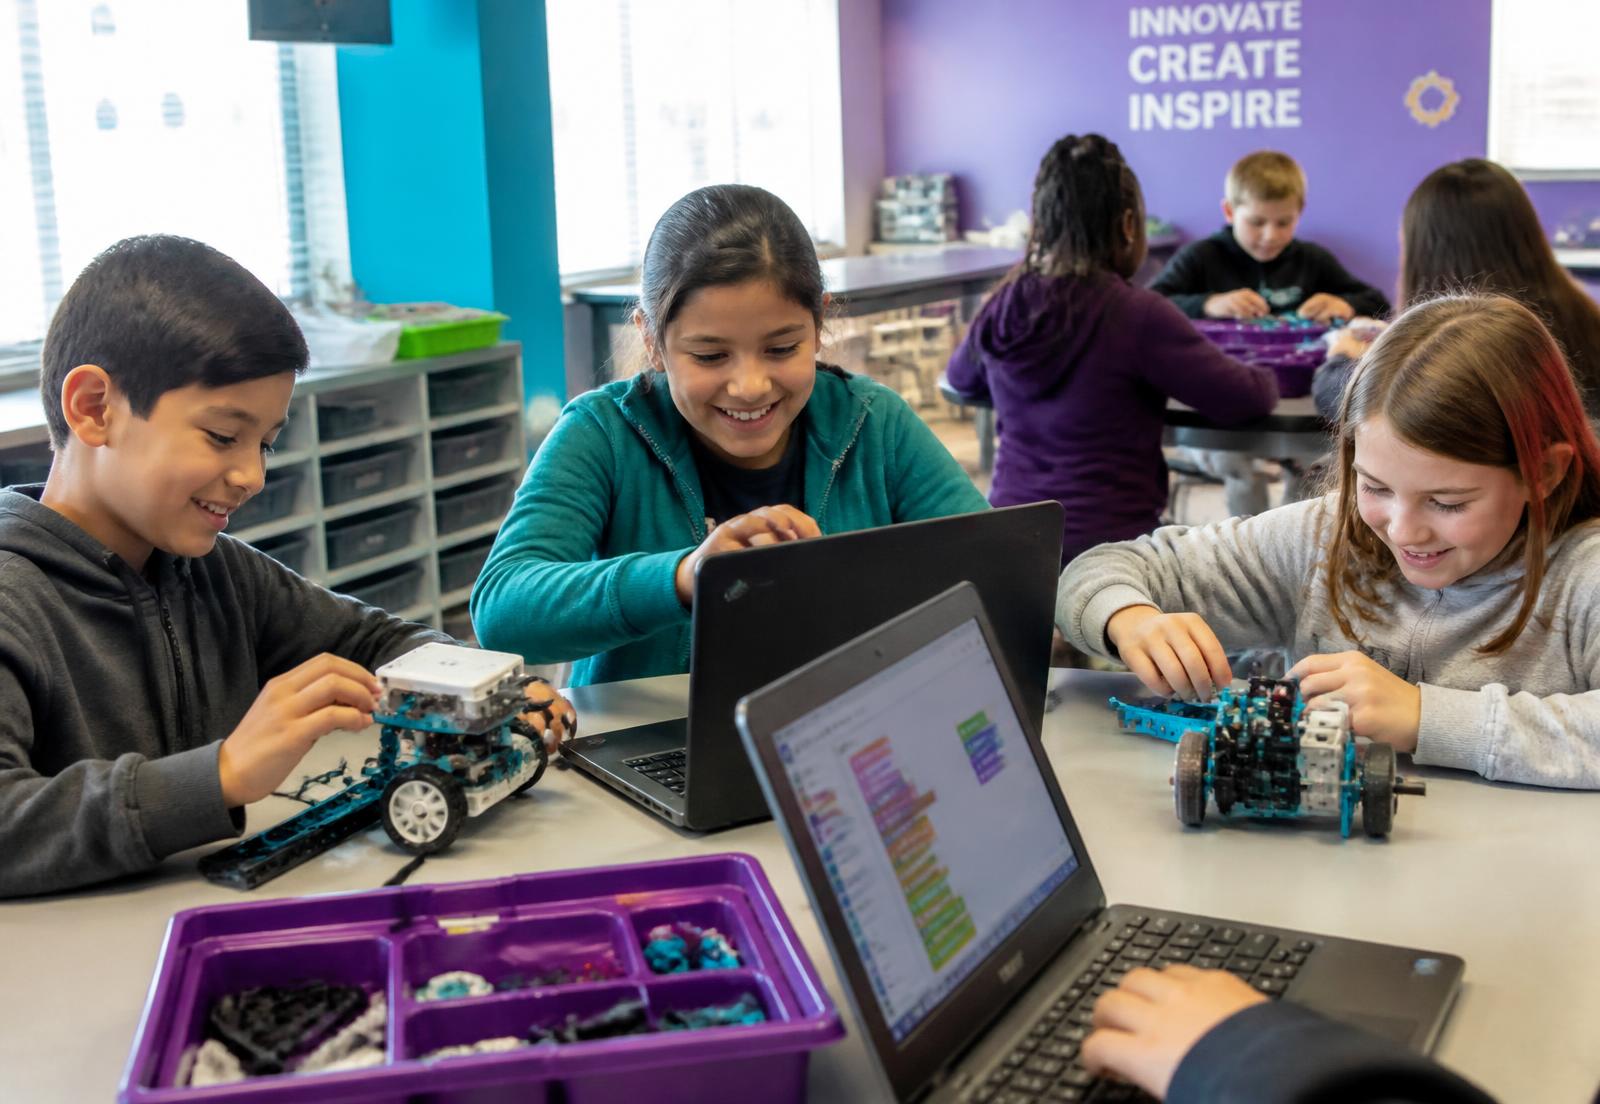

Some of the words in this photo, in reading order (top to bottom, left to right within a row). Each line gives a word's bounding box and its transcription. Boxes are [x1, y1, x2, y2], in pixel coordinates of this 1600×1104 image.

[1129, 1, 1301, 37] INNOVATE
[1128, 39, 1301, 83] CREATE
[1129, 88, 1302, 131] INSPIRE
